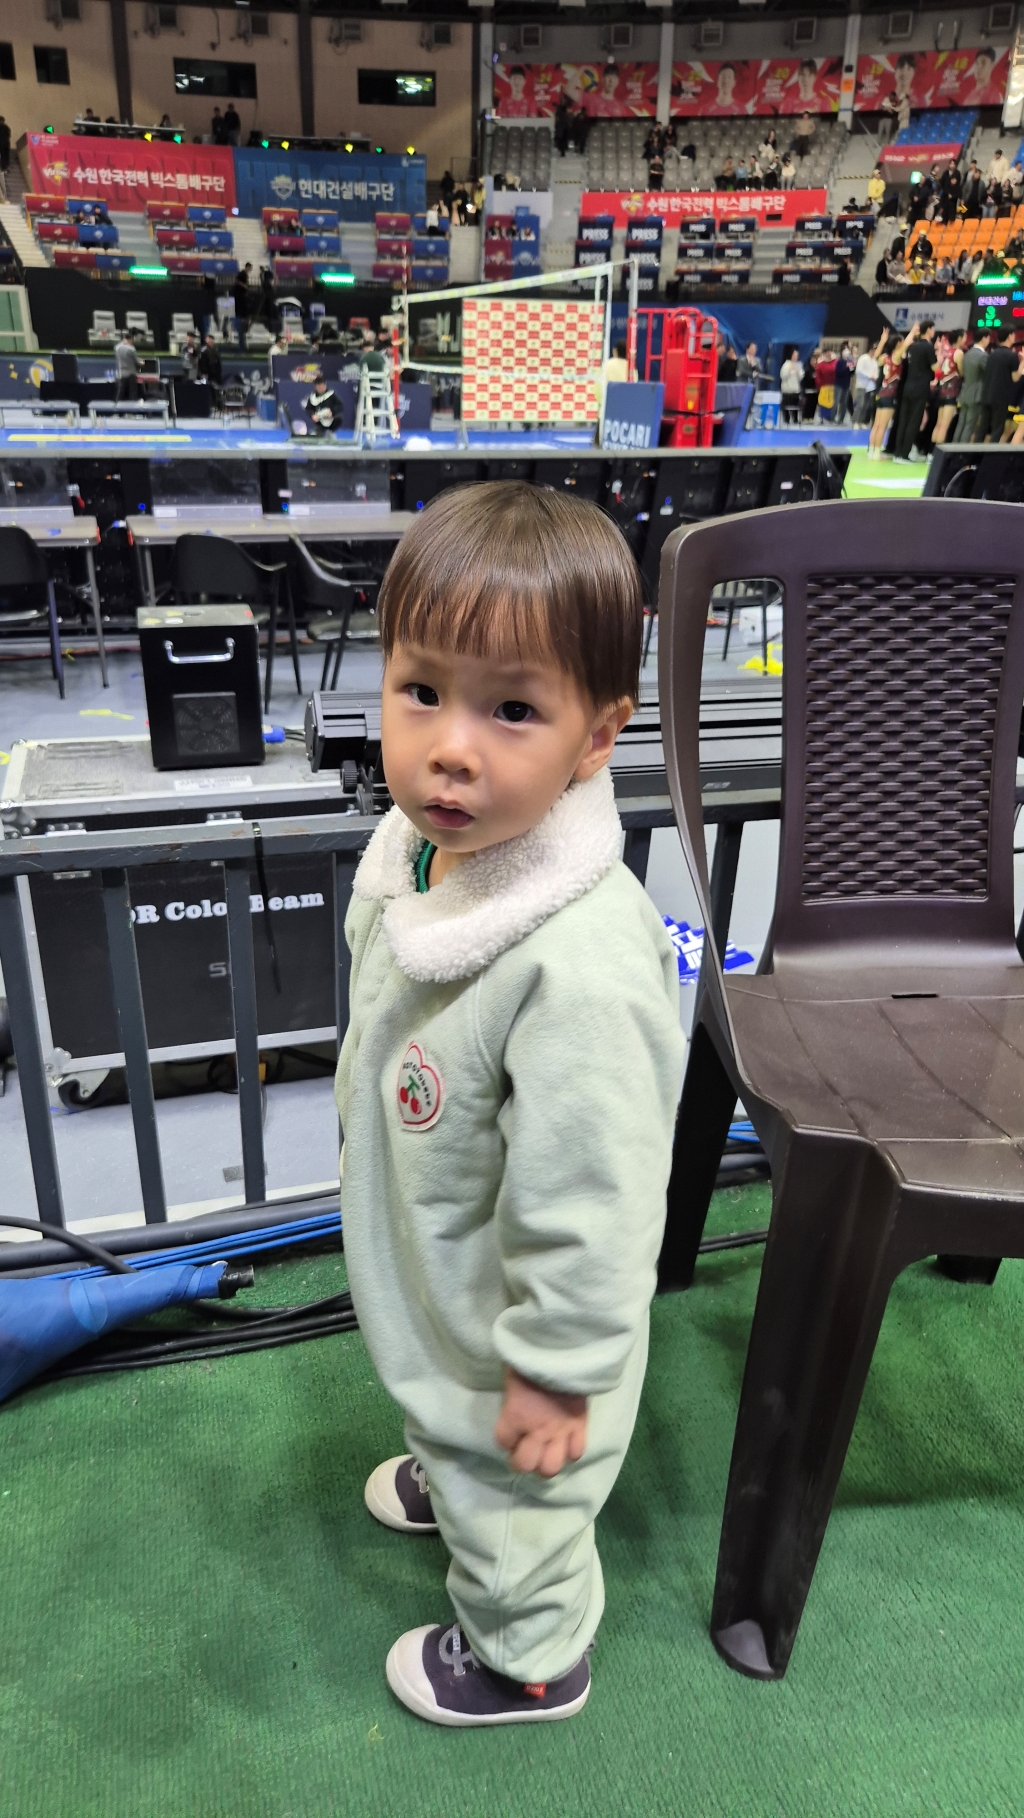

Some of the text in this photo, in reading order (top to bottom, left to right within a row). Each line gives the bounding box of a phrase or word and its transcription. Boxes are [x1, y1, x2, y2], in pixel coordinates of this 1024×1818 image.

[297, 179, 395, 202] 현대건설배구단
[582, 228, 610, 241] PRESS
[631, 228, 659, 241] PRESS
[603, 419, 652, 448] POCARI
